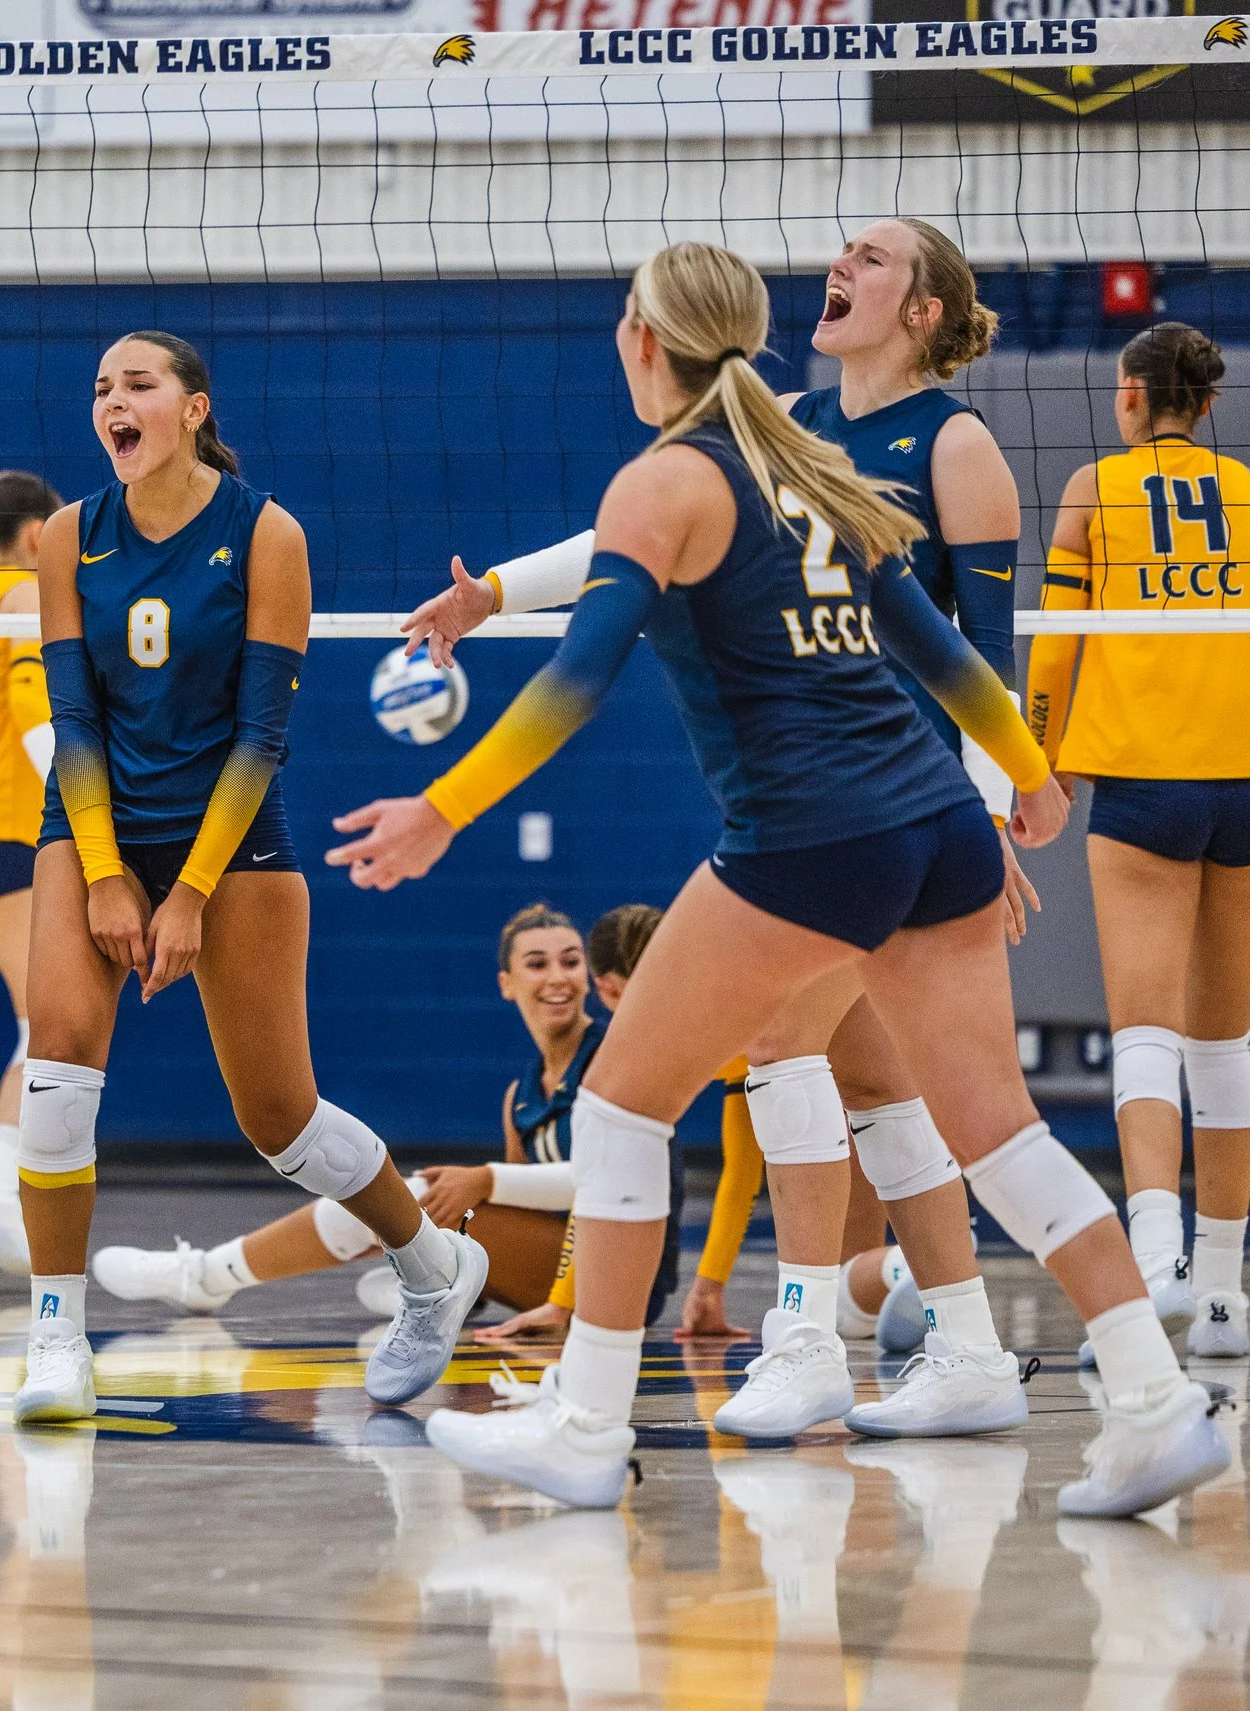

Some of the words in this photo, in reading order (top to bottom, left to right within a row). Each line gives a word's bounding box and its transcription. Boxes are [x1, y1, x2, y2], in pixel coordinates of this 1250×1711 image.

[156, 36, 331, 73] EAGLES
[579, 29, 692, 65] LCCC
[712, 25, 897, 61] GOLDEN
[915, 20, 1098, 58] EAGLES
[777, 484, 853, 598] 2
[1142, 474, 1232, 555] 14
[1138, 563, 1242, 601] LCCC
[128, 598, 171, 668] 8
